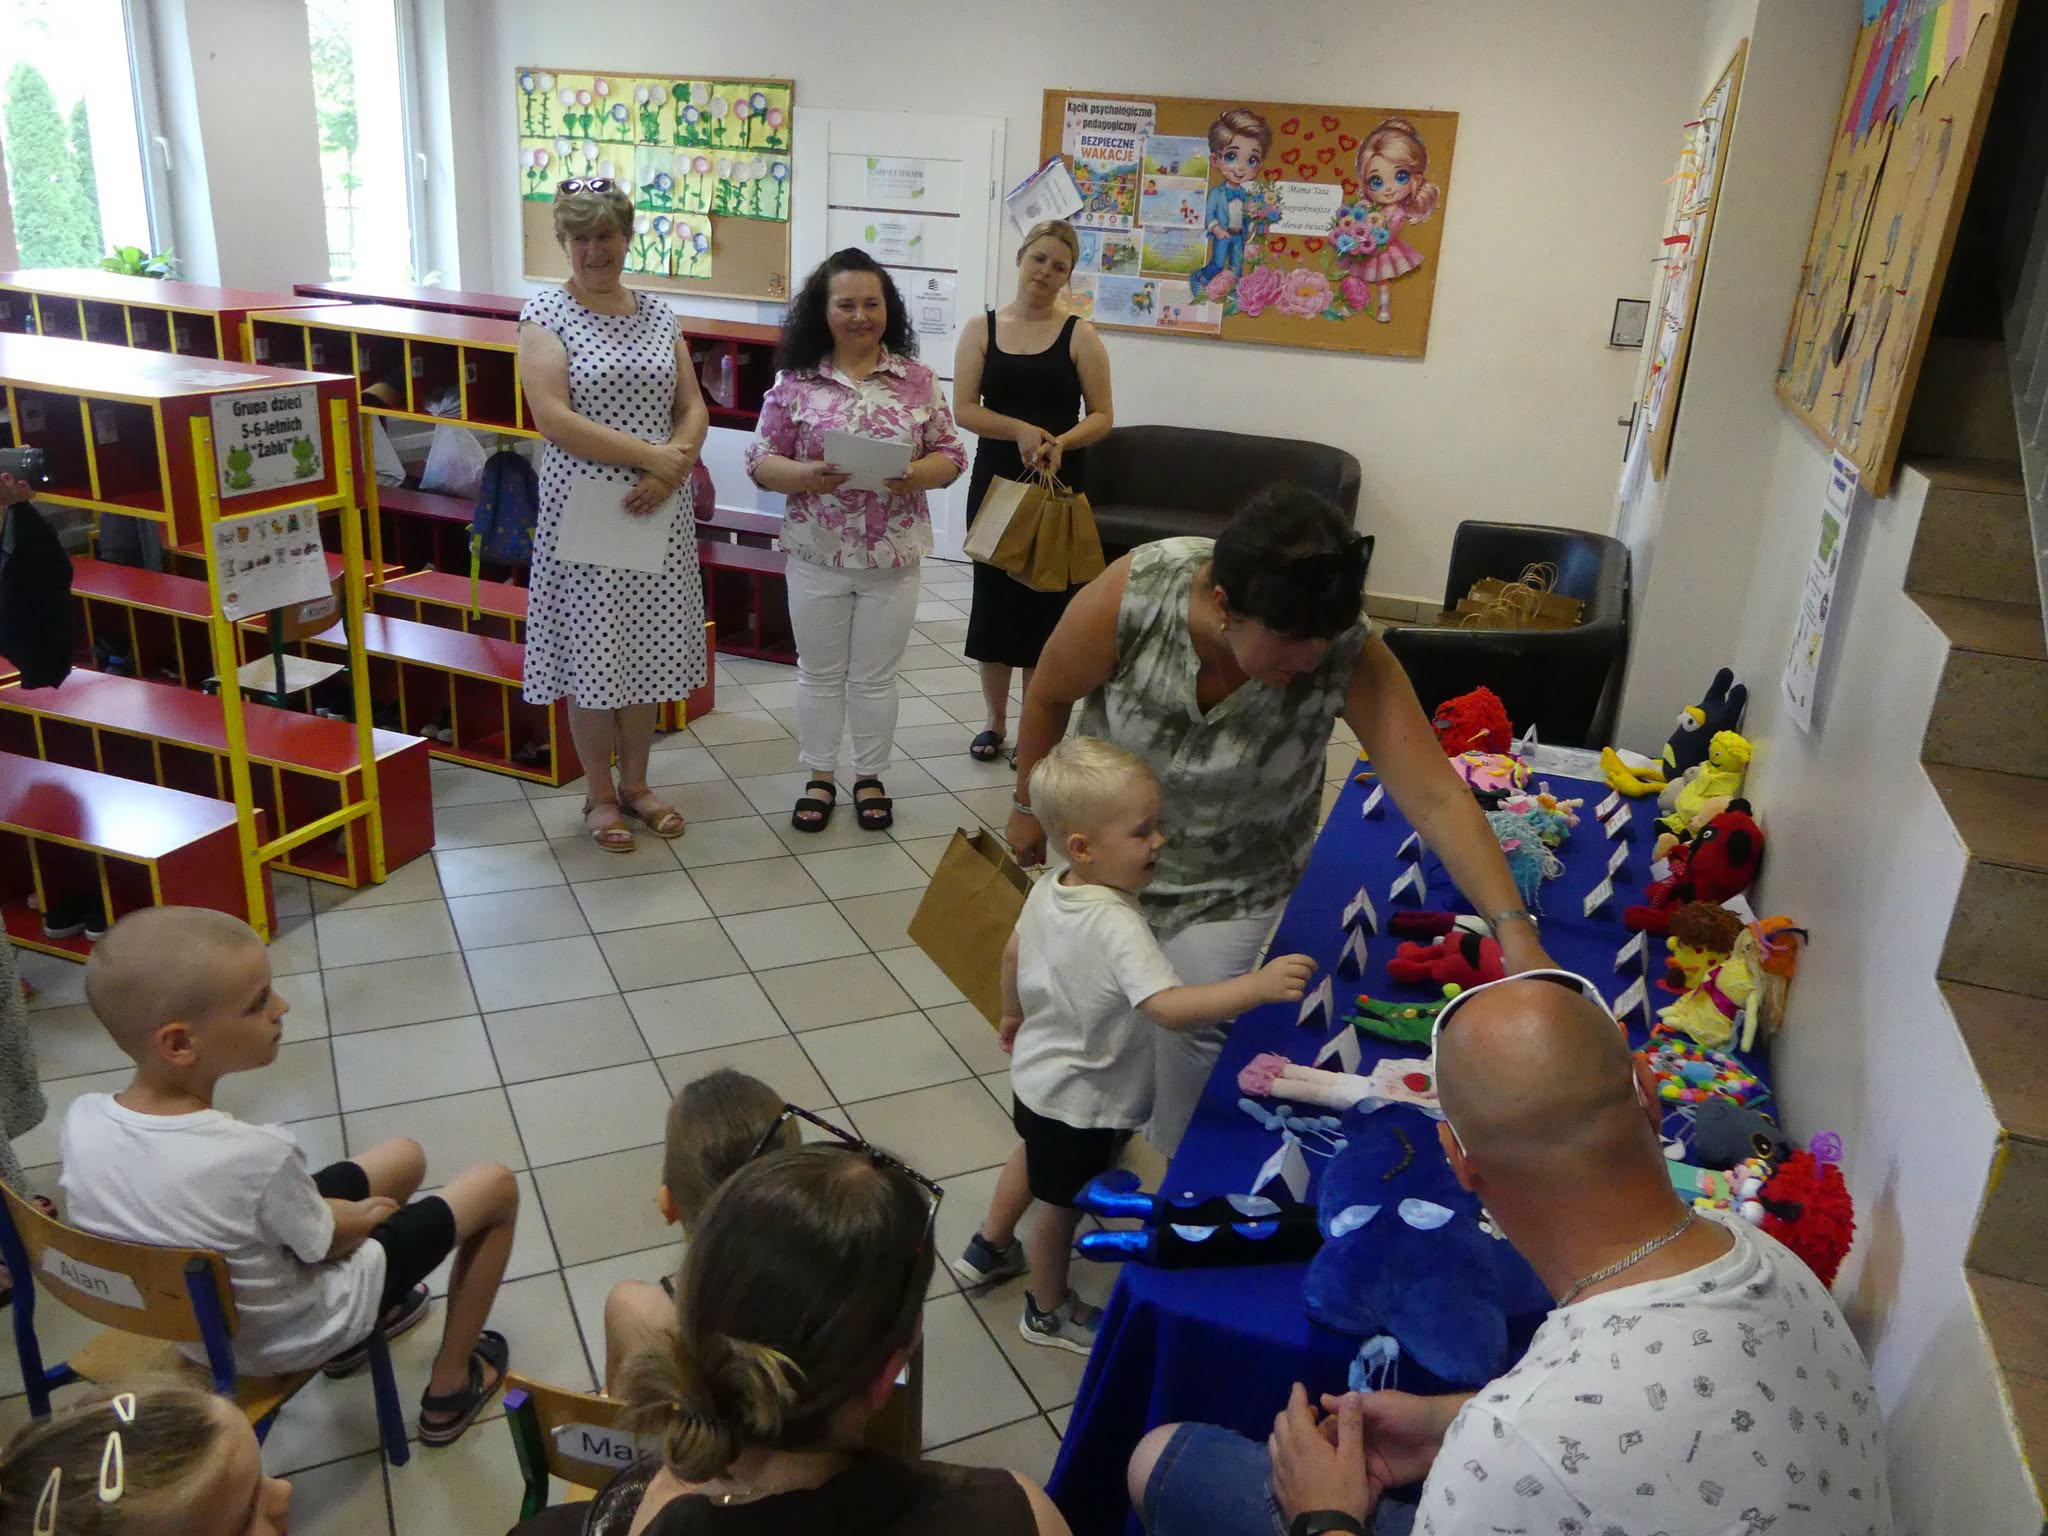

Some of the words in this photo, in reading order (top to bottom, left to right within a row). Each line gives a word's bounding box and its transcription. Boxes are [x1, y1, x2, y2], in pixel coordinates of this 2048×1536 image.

[1067, 102, 1088, 115] Kącik
[1082, 119, 1137, 133] pedagogiczny
[1081, 135, 1135, 149] BEZPIECZNE
[1081, 147, 1134, 161] WAKACJE
[233, 401, 268, 416] Grupa
[272, 394, 302, 411] dzieci
[242, 416, 302, 438] 5-6-letnich
[60, 1261, 110, 1294] Alan
[582, 1431, 636, 1460] Ma
